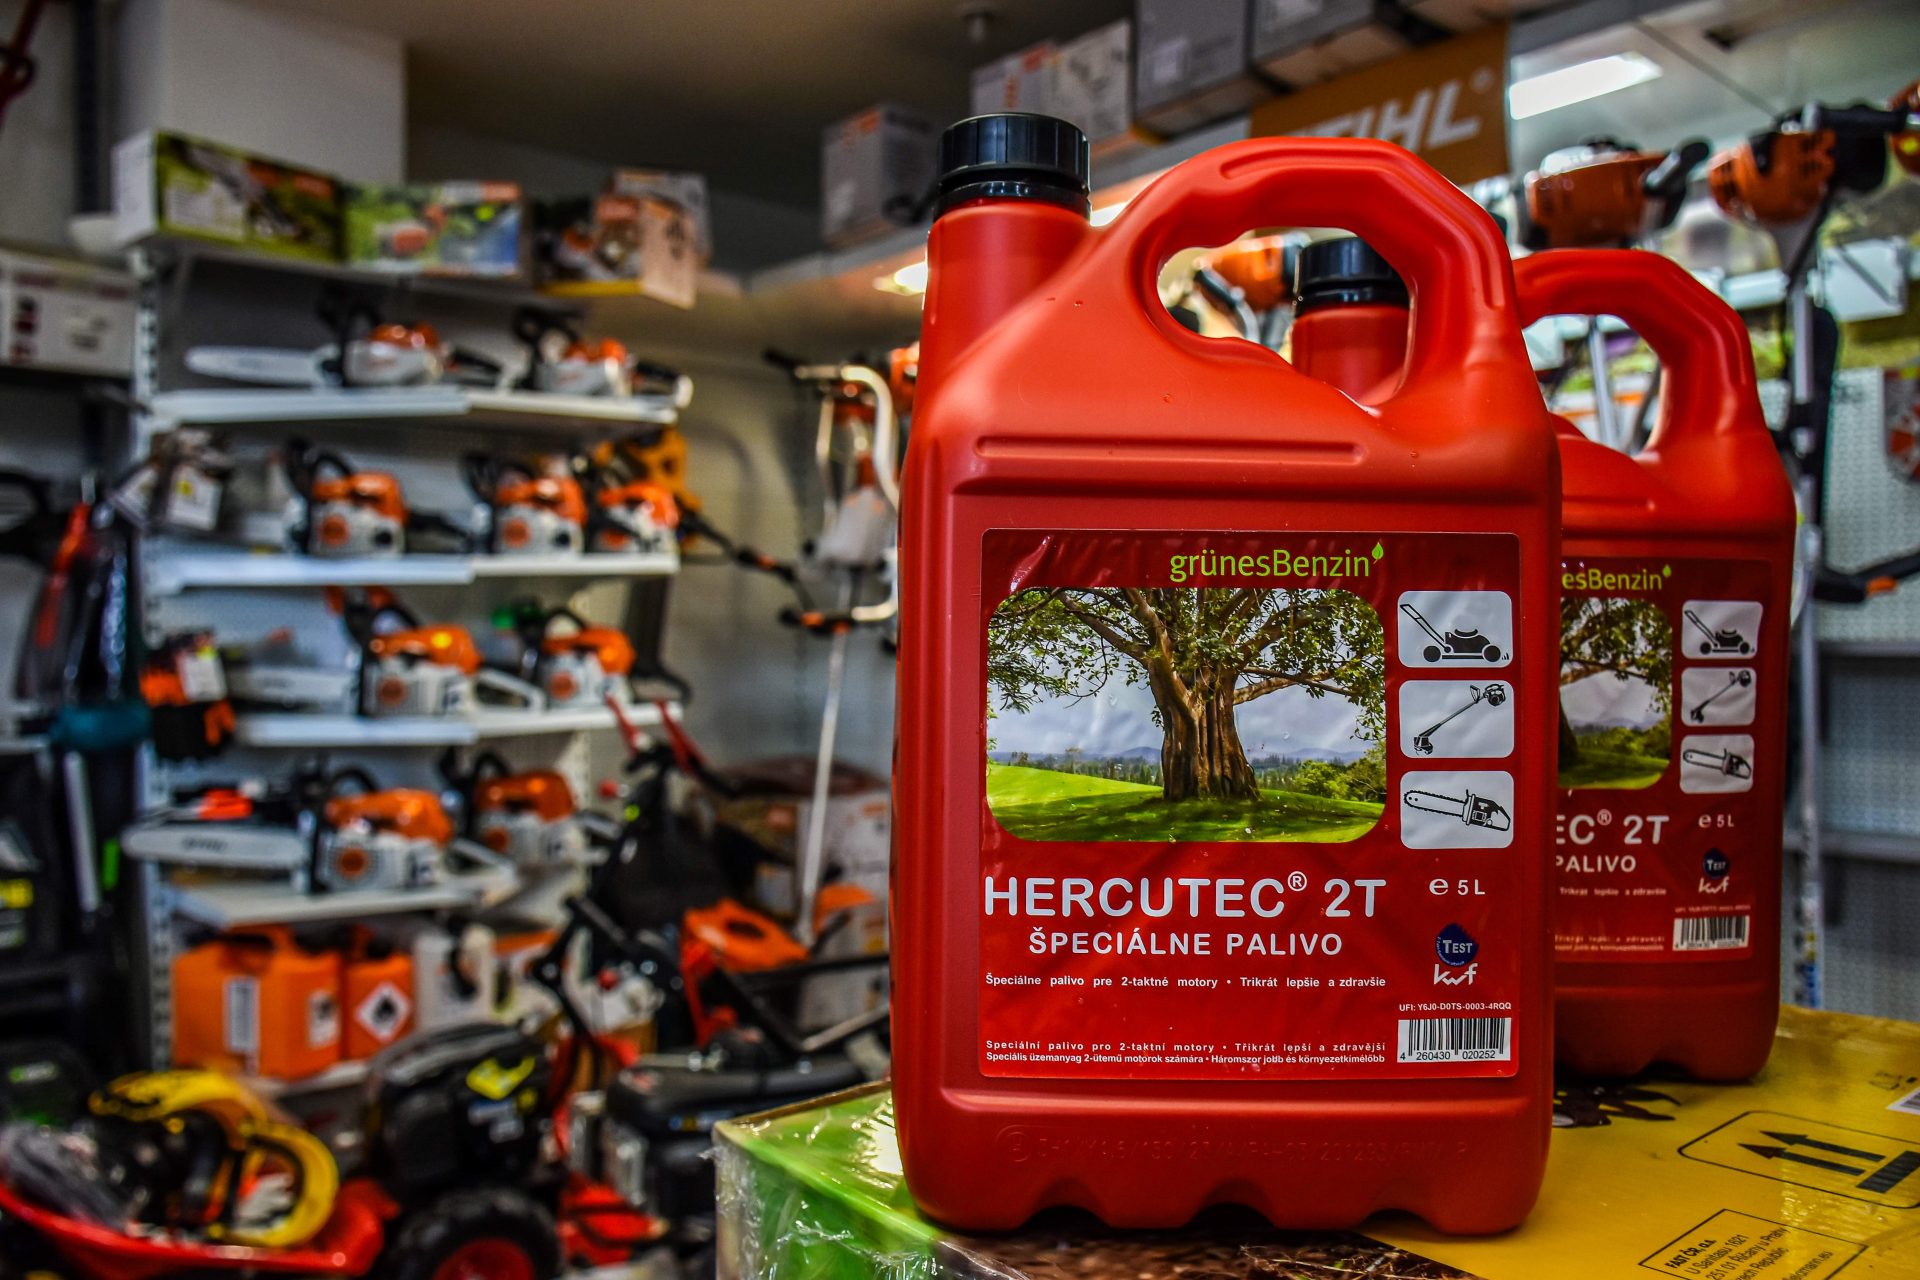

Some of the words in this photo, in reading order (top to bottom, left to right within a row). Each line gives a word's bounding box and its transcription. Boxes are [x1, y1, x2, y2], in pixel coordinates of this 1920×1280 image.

[1170, 549, 1370, 582] grünesBenzin
[1561, 567, 1663, 590] esBenzin
[1717, 814, 1725, 828] 5
[1728, 814, 1735, 828] L
[1623, 815, 1670, 845] 2T
[985, 871, 1308, 918] HERCUTEC®
[1324, 879, 1387, 918] 2T
[1457, 879, 1469, 896] 5
[1474, 879, 1486, 895] L
[1029, 926, 1211, 955] ŠPECIÁLNE
[1226, 933, 1343, 956] PALIVO
[986, 973, 1042, 987] Špeciálne
[1050, 976, 1085, 988] palivo
[1093, 978, 1113, 988] pre
[1121, 976, 1169, 987] 2-taktné
[1177, 978, 1218, 989] motory
[1240, 977, 1278, 987] Trikrát
[1286, 977, 1320, 989] lepšie
[1339, 977, 1386, 987] zdravšie
[1399, 1004, 1416, 1012] UFI:
[986, 1040, 1041, 1050] Speciální
[1048, 1041, 1084, 1051] palivo
[1092, 1043, 1112, 1052] pro
[1119, 1042, 1166, 1052] 2-taktní
[1173, 1043, 1215, 1053] motory
[1234, 1042, 1275, 1052] Třikrát
[1332, 1042, 1386, 1052] zdravější
[986, 1052, 1028, 1061] Speciális
[1029, 1053, 1082, 1063] üzemanyag
[1124, 1055, 1163, 1063] motorok
[1164, 1055, 1204, 1063] számára
[1211, 1054, 1262, 1064] Háromszor
[1416, 1052, 1451, 1061] 260430
[1462, 1051, 1496, 1060] 020252
[1725, 1234, 1749, 1247] 1621
[1664, 1255, 1690, 1268] FAST
